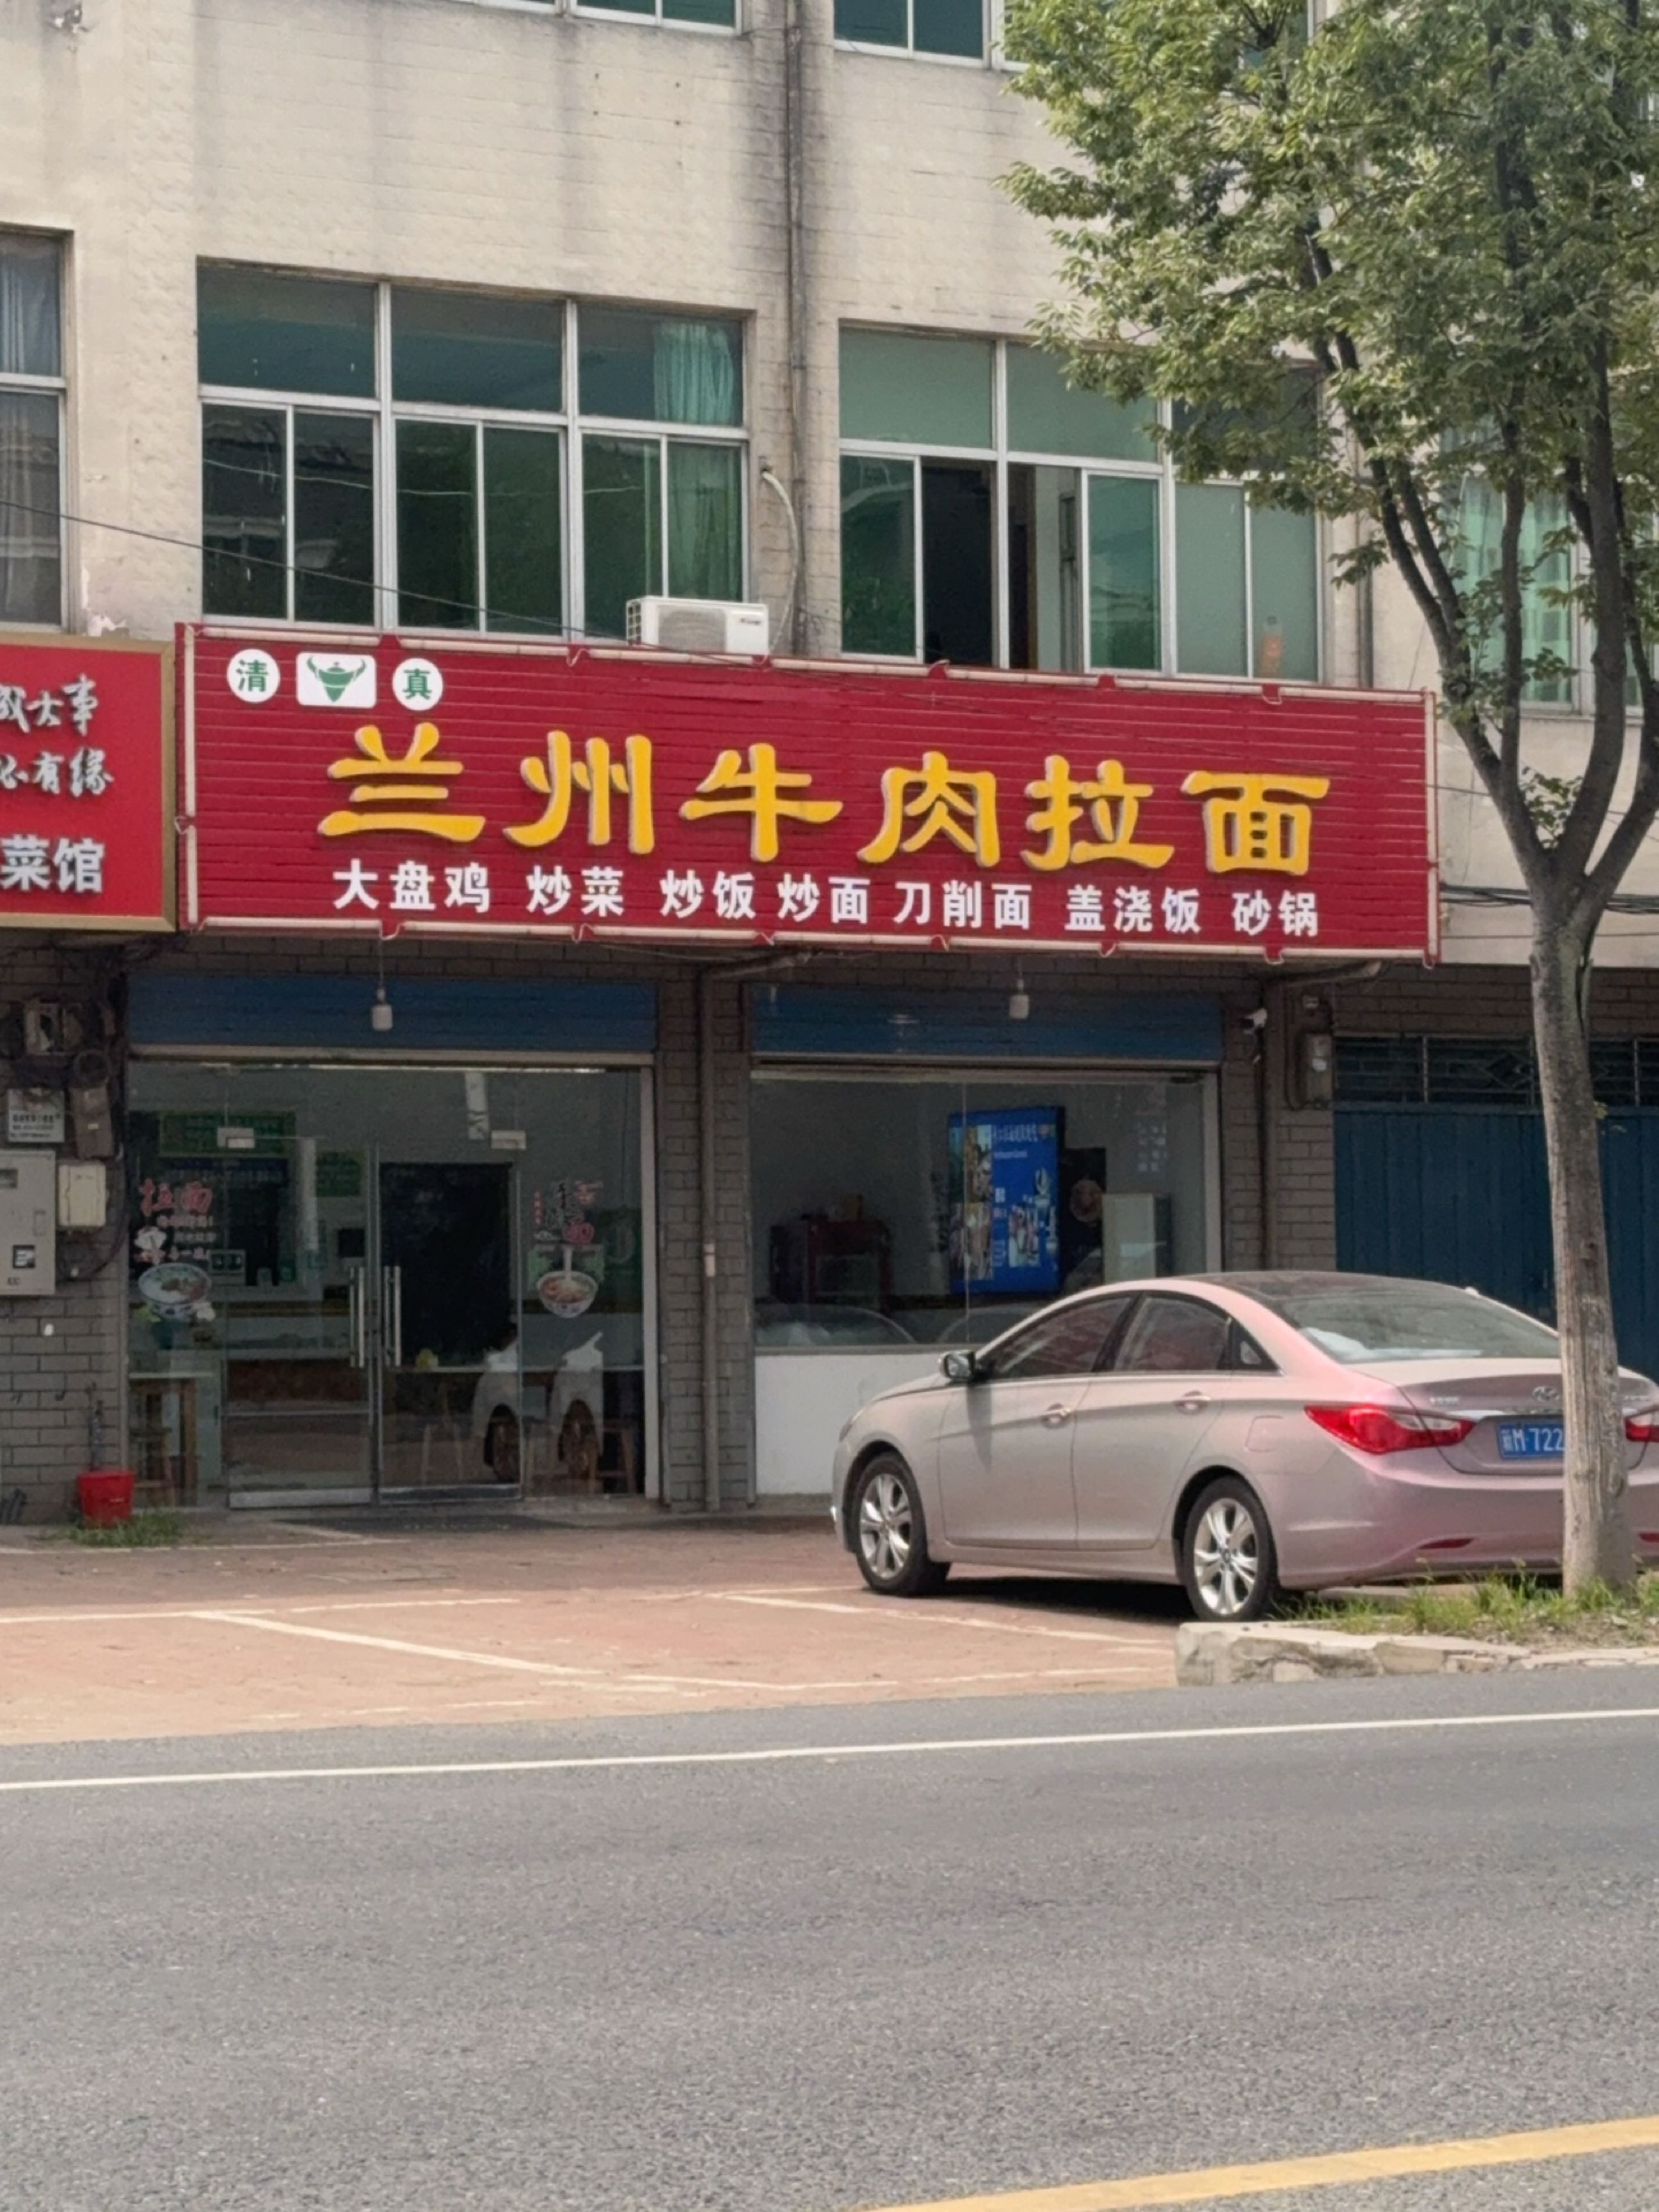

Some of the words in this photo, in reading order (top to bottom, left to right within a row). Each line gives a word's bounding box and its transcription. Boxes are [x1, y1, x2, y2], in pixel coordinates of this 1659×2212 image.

[236, 659, 269, 693] 清
[403, 668, 432, 701] 真
[318, 721, 1331, 877] 兰州牛肉拉面
[0, 834, 105, 893] 菜馆
[333, 858, 491, 913] 大盘鸡
[525, 864, 625, 918] 炒菜
[659, 869, 757, 919] 炒饭
[776, 872, 871, 924] 炒面
[893, 879, 1032, 930] 刀削面
[1064, 884, 1202, 933] 盖浇饭
[1231, 890, 1319, 938] 砂锅
